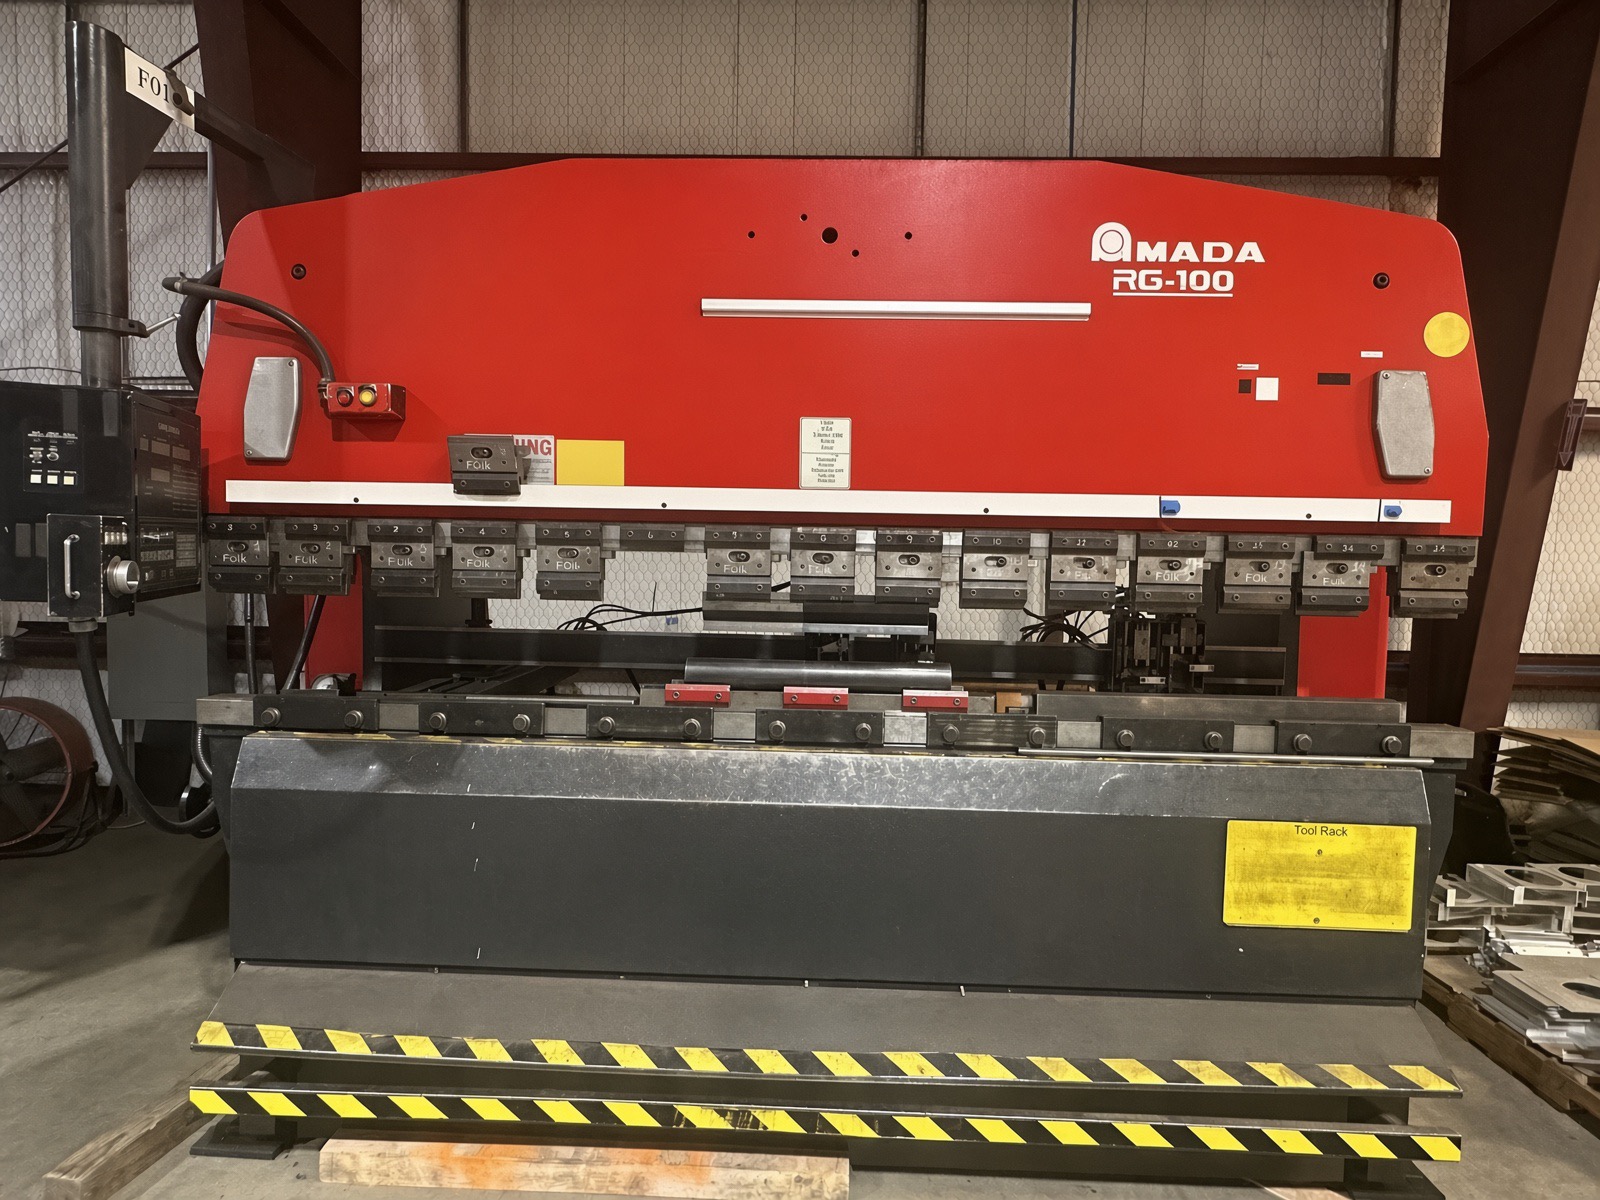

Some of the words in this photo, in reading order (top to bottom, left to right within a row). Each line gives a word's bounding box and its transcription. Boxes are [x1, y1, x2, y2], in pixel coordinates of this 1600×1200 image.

[1091, 221, 1265, 263] AMADA
[1112, 269, 1234, 292] RG-100
[1294, 825, 1317, 836] Tool
[1320, 825, 1348, 837] Rack
